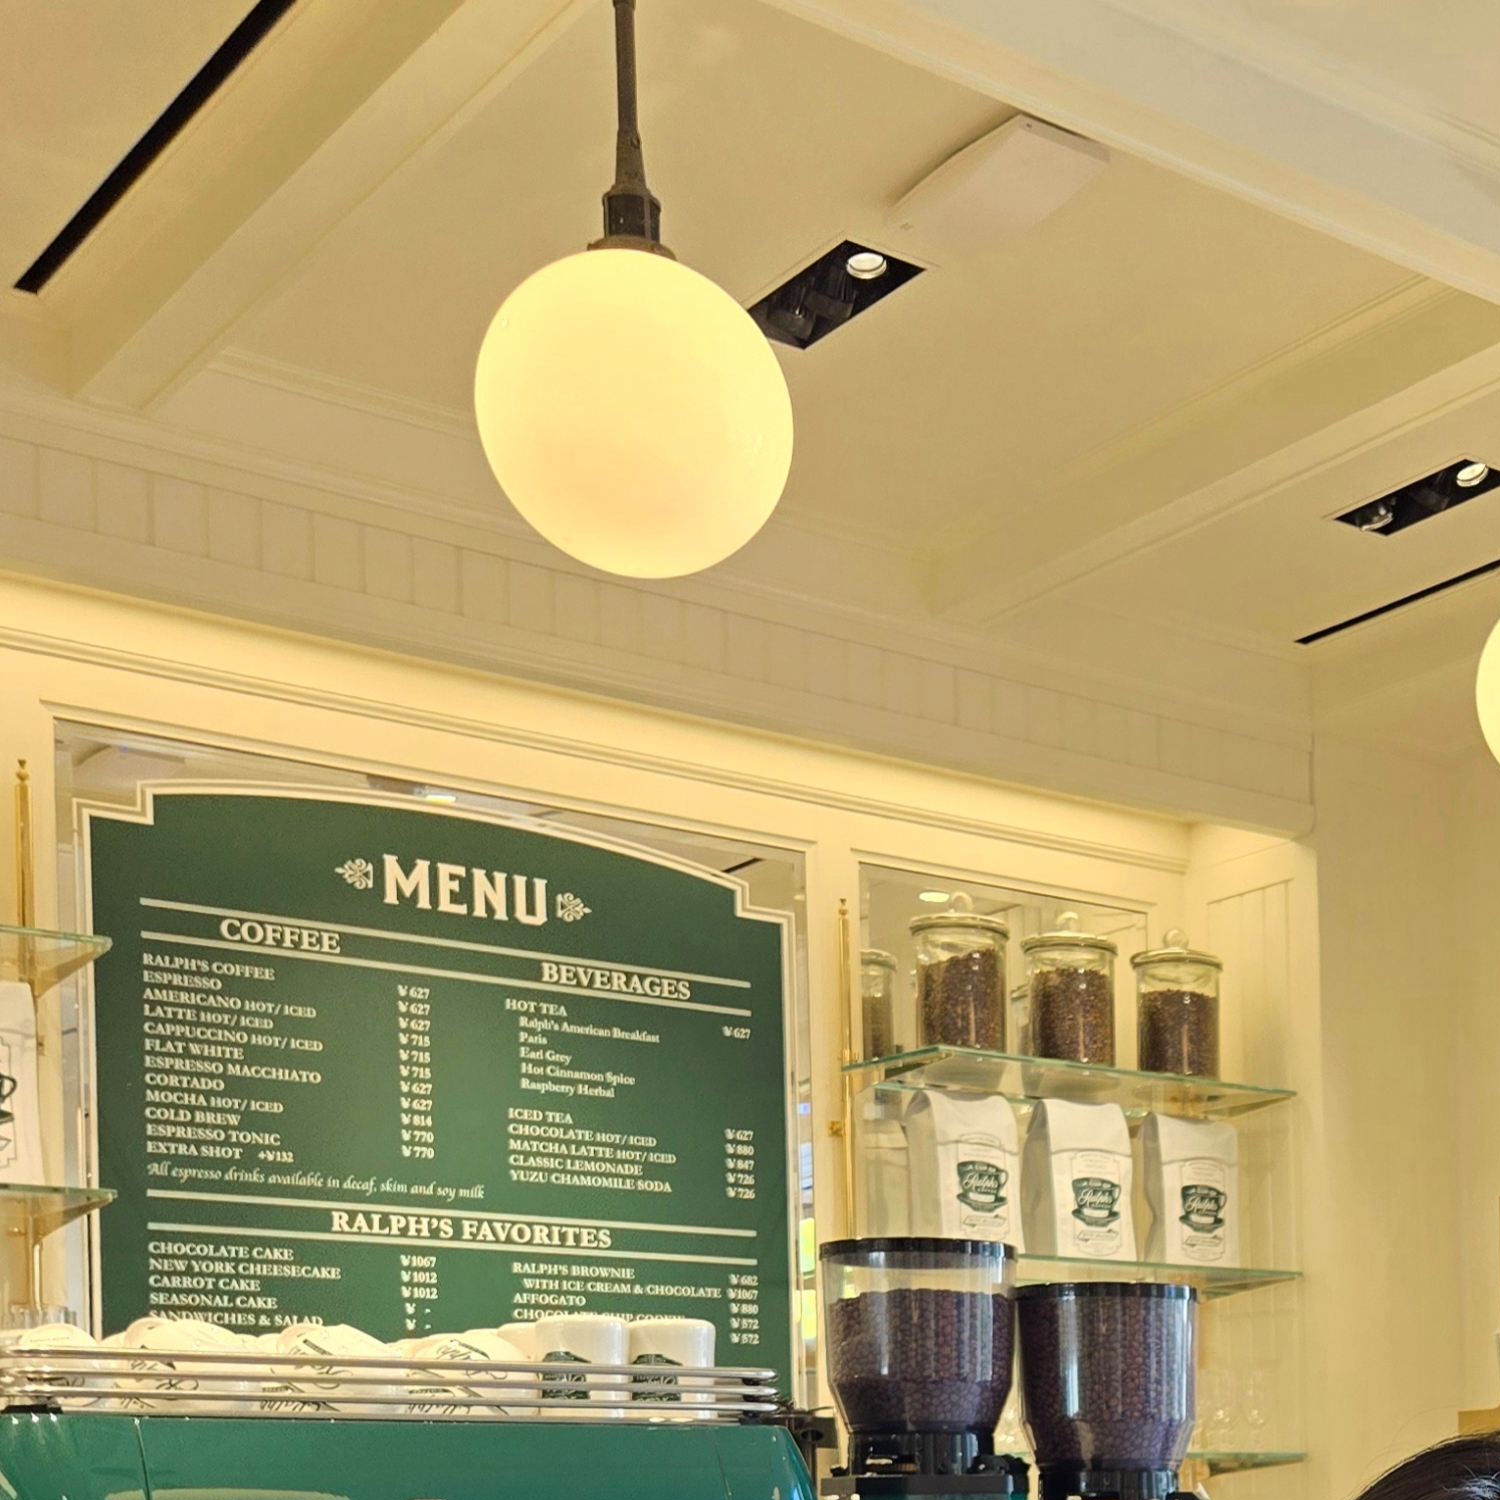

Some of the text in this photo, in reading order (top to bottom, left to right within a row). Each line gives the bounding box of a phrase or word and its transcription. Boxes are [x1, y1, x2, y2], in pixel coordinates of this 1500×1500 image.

[383, 854, 548, 926] MENU
[220, 918, 341, 953] COFFEE
[142, 953, 275, 980] RALPH'S COFFEE
[143, 970, 222, 990] ESPRESSO
[541, 962, 691, 1000] BEVERAGES
[143, 988, 241, 1009] AMERICANO
[284, 1005, 317, 1018] ICED
[505, 998, 568, 1017] HOT TEA
[143, 1004, 197, 1021] LATTE
[240, 1016, 274, 1029] ICED
[143, 1022, 248, 1043] CAPPUCCINO
[290, 1039, 323, 1052] ICED
[519, 1016, 661, 1043] Ralph's American Breakfast
[519, 1032, 548, 1045] Paris
[144, 1038, 244, 1060] FLAT WHITE
[520, 1047, 572, 1066] Earl Grey
[144, 1056, 322, 1084] ESPRESSO MACCHIATO
[521, 1063, 636, 1086] Hot Cinnamon Spice
[145, 1074, 225, 1091] CORTADO
[521, 1078, 615, 1098] Raspberry Herbal
[146, 1090, 208, 1106] MOCHA
[250, 1100, 284, 1113] ICED
[145, 1107, 241, 1126] COLD BREW
[508, 1108, 573, 1124] ICED TEA
[146, 1124, 281, 1146] ESPRESSO TONIC
[508, 1124, 594, 1142] CHOCOLATE
[630, 1135, 658, 1147] ICED
[146, 1141, 198, 1156] EXTRA
[201, 1145, 244, 1159] SHOT
[508, 1139, 568, 1154] MATCHA
[571, 1144, 614, 1158] LATTE
[650, 1152, 676, 1164] ICED
[509, 1154, 643, 1176] CLASSIC LEMONADE
[148, 1161, 172, 1176] All
[172, 1164, 222, 1183] espresso
[224, 1166, 266, 1182] drinks
[268, 1170, 324, 1188] available
[327, 1176, 340, 1188] in
[380, 1178, 408, 1193] skim
[410, 1182, 436, 1195] and
[436, 1188, 456, 1202] soy
[459, 1184, 485, 1199] milk
[510, 1170, 672, 1192] YUZU CHAMOMILE SODA
[331, 1211, 612, 1248] RALPH'S FAVORITES
[148, 1241, 294, 1260] CHOCOLATE CAKE
[149, 1258, 341, 1280] NEW YORK CHEESECAKE
[512, 1262, 635, 1280] RALPH'S BROWNIE
[149, 1275, 261, 1292] CARROT CAKE
[523, 1278, 722, 1298] WITH ICE CREAM & CHOCOLATE
[149, 1292, 278, 1310] SEASONAL CAKE
[514, 1293, 586, 1306] AFFOGATO
[259, 1316, 271, 1326] &
